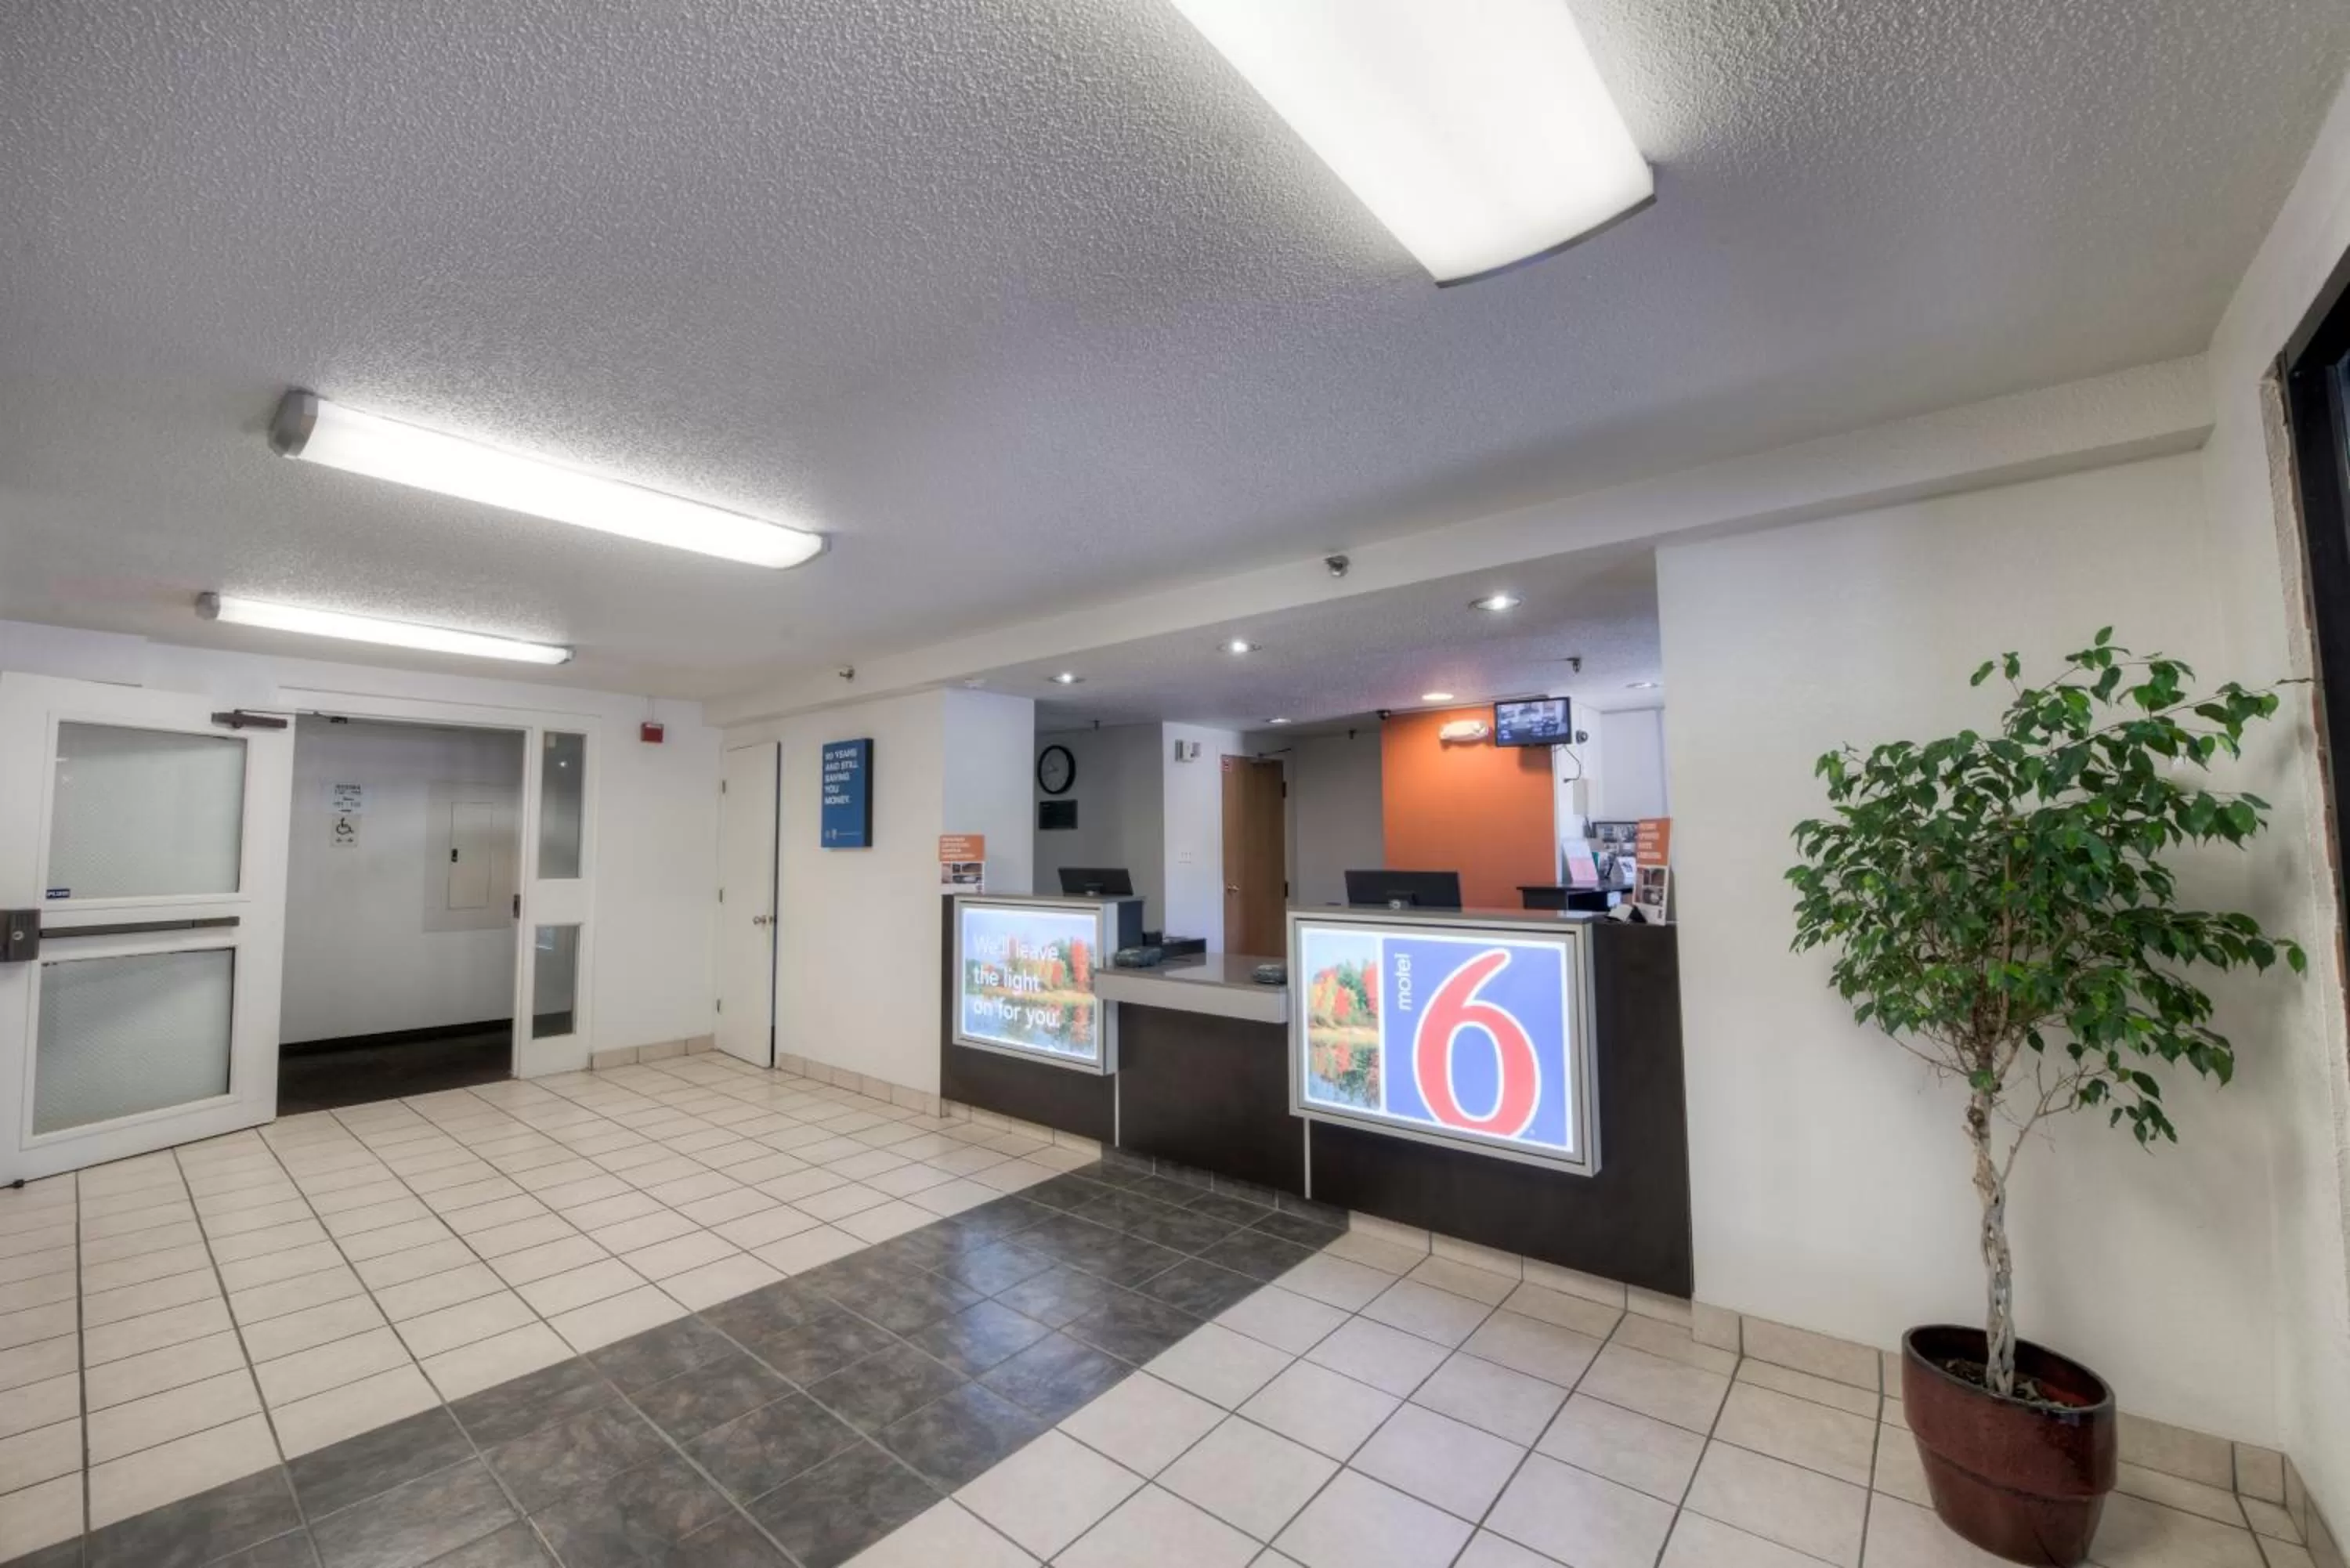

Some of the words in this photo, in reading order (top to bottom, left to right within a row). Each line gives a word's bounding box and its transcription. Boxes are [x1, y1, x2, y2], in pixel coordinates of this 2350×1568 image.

[825, 762, 840, 771] AND
[841, 760, 859, 770] STILL
[825, 771, 850, 782] SAVING
[824, 784, 839, 793] YOU
[1015, 938, 1059, 961] leave
[974, 964, 999, 987] the
[1003, 965, 1041, 995] light
[1394, 952, 1412, 1010] motel
[974, 999, 995, 1017] on
[996, 996, 1021, 1022] for
[1412, 948, 1541, 1139] 6
